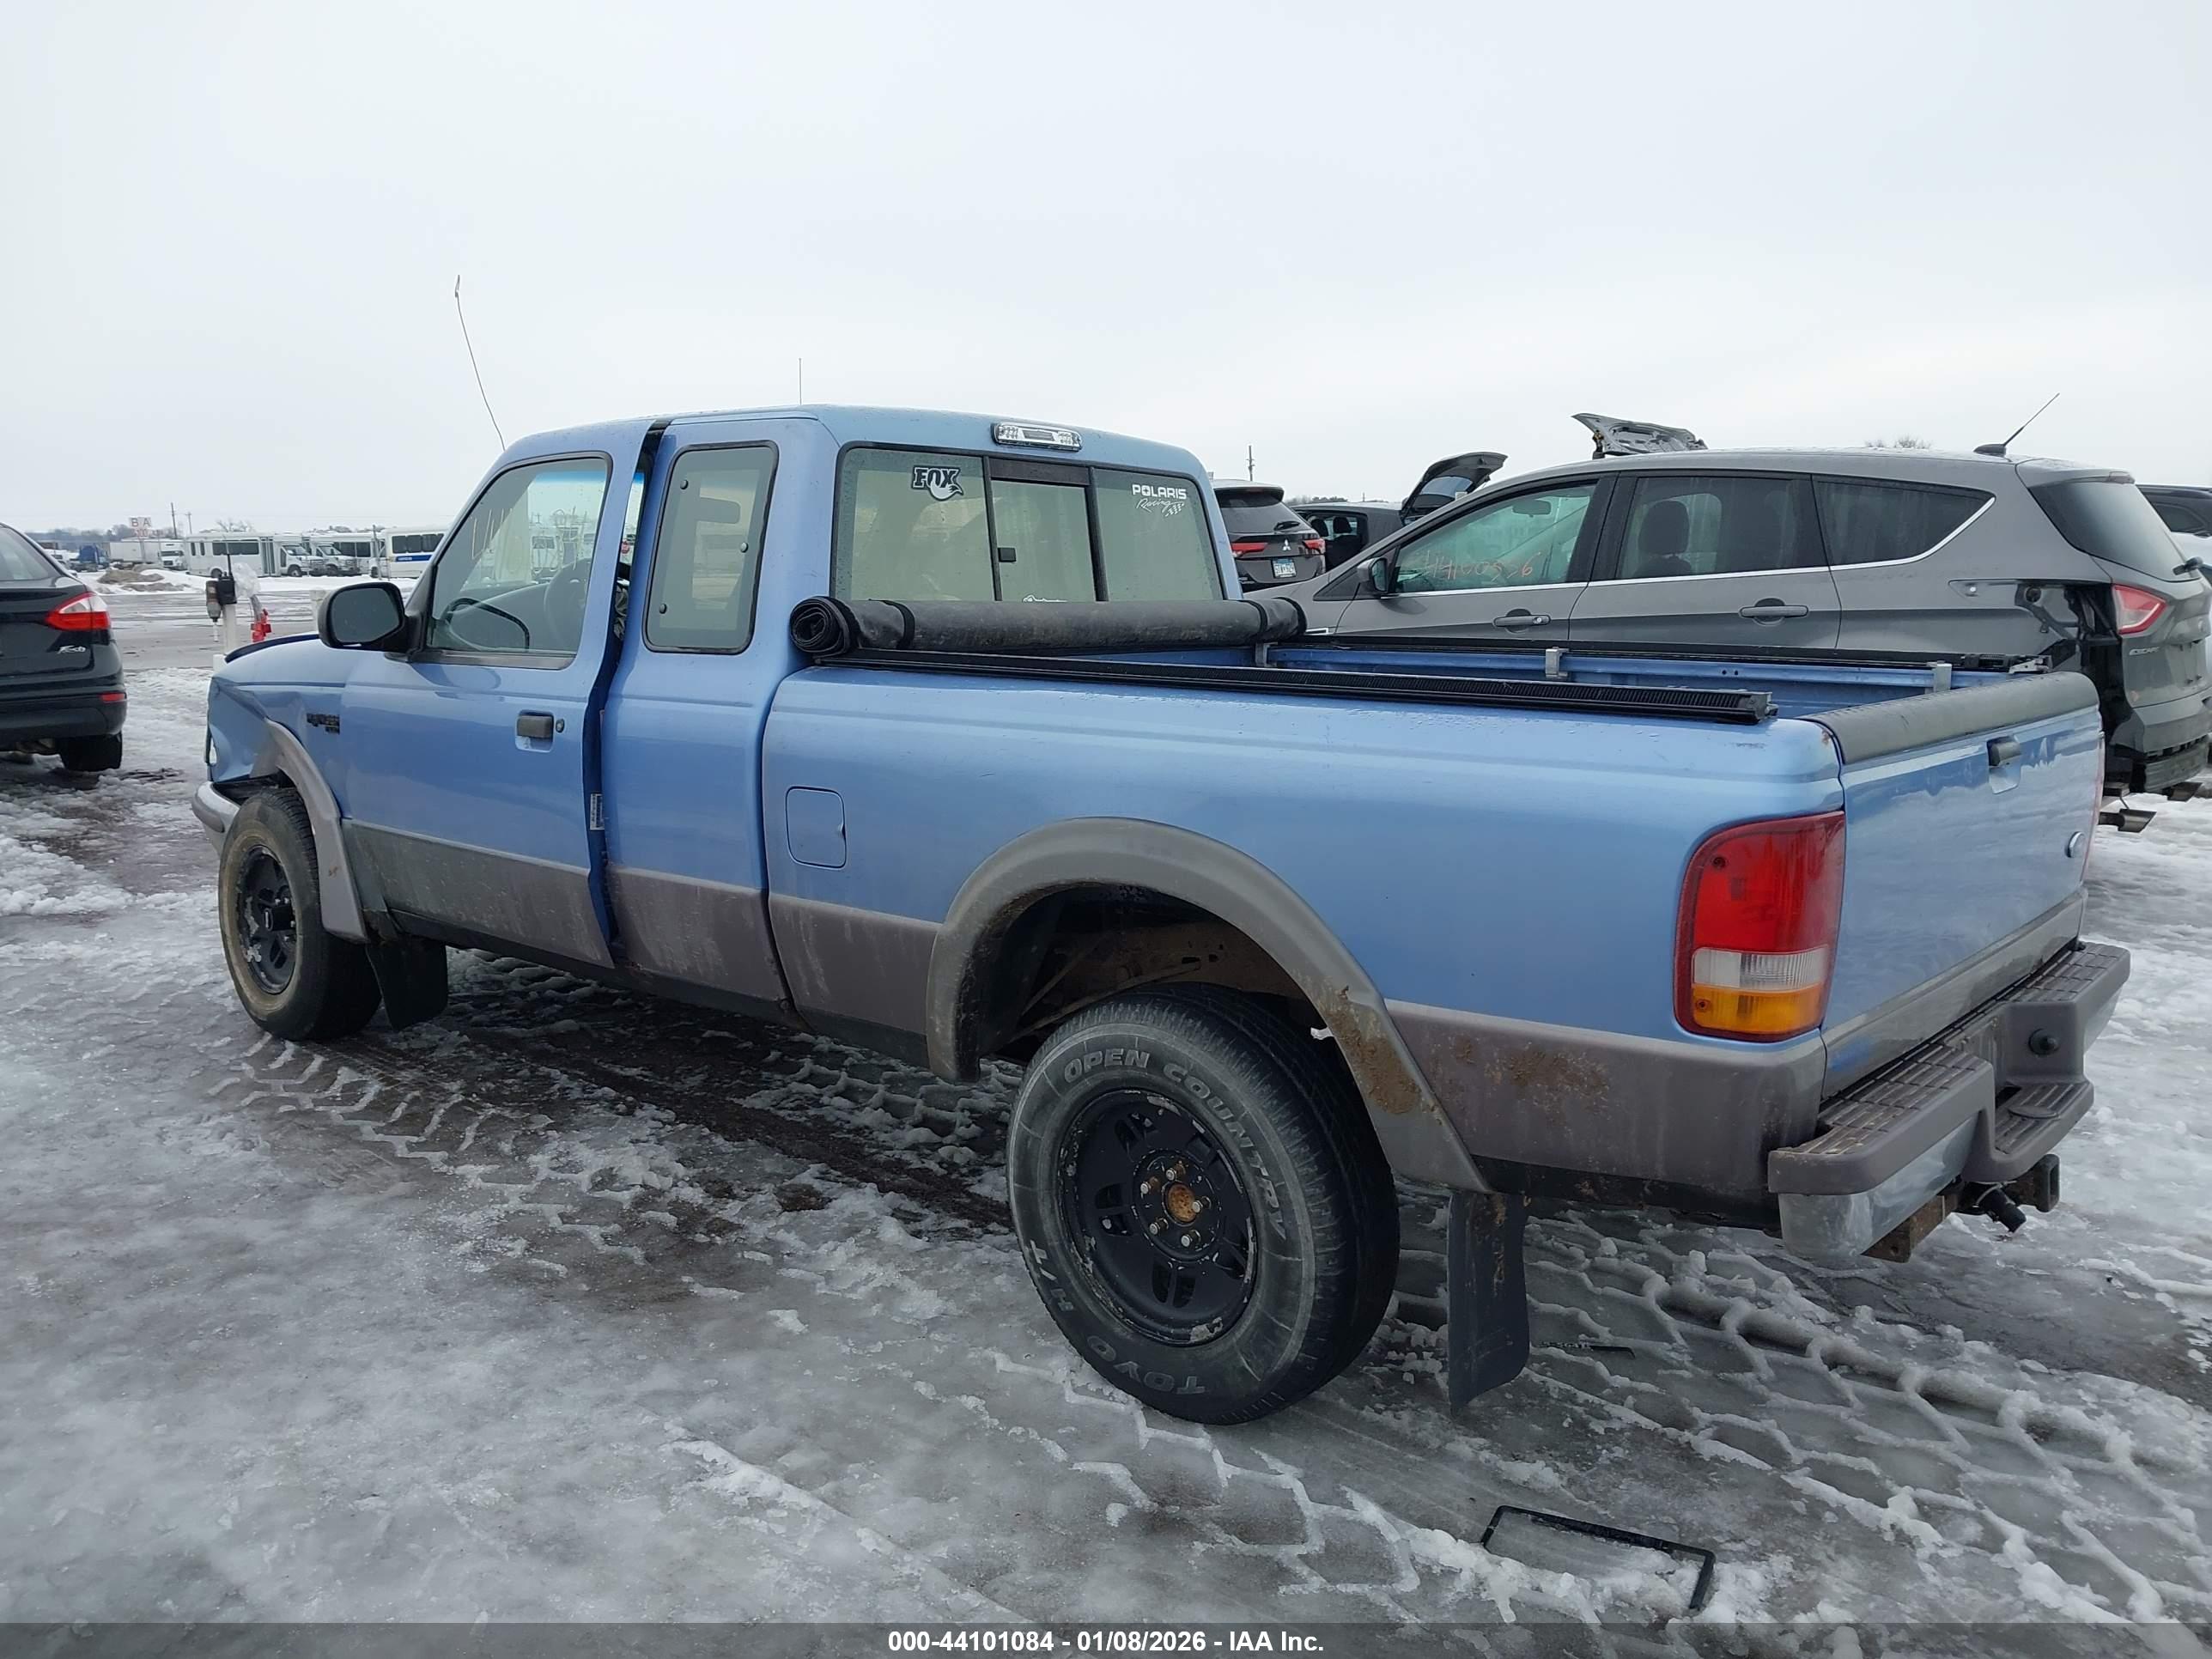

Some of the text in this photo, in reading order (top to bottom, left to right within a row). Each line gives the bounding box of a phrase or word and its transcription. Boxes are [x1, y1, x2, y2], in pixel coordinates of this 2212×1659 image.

[912, 465, 962, 489] FOX
[1132, 483, 1187, 500] POLARIS
[1063, 1048, 1287, 1241] OPEN COUNTRY
[1086, 1334, 1206, 1395] TOYO
